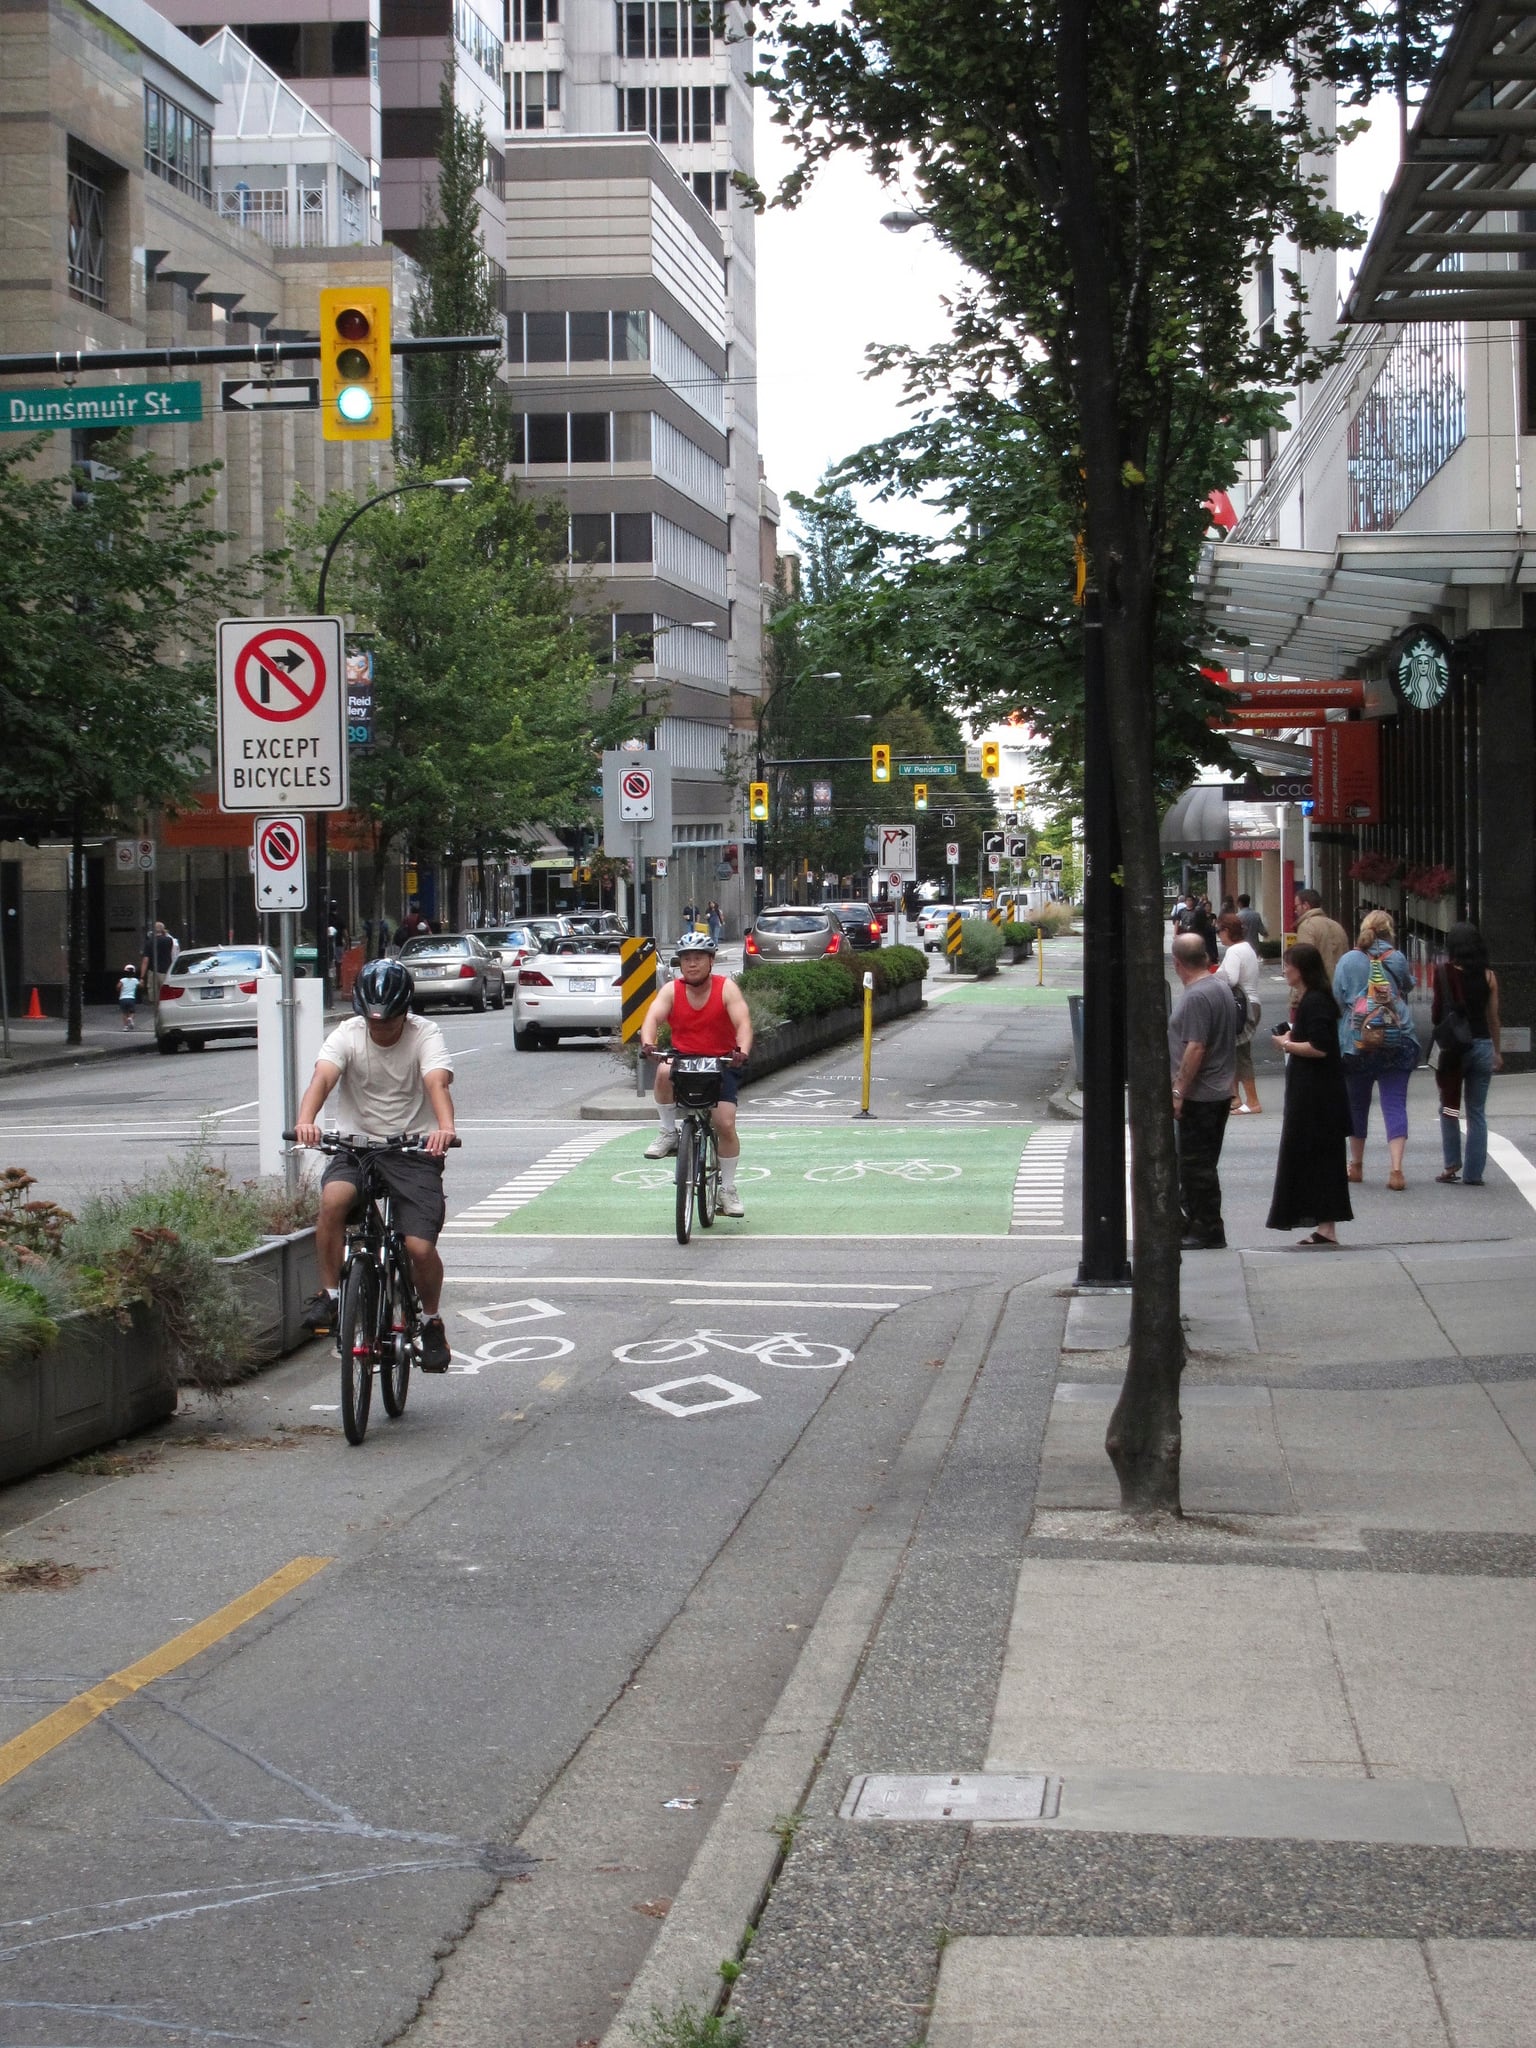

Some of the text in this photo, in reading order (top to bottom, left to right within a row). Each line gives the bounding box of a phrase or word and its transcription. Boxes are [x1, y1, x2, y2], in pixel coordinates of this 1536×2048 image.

[9, 391, 182, 424] Dunsmuir St.
[1256, 687, 1353, 696] STEAMROLLERS
[348, 696, 372, 706] Reid
[347, 706, 367, 717] lery
[243, 738, 320, 760] EXCEPT
[234, 766, 331, 789] BICYCLES
